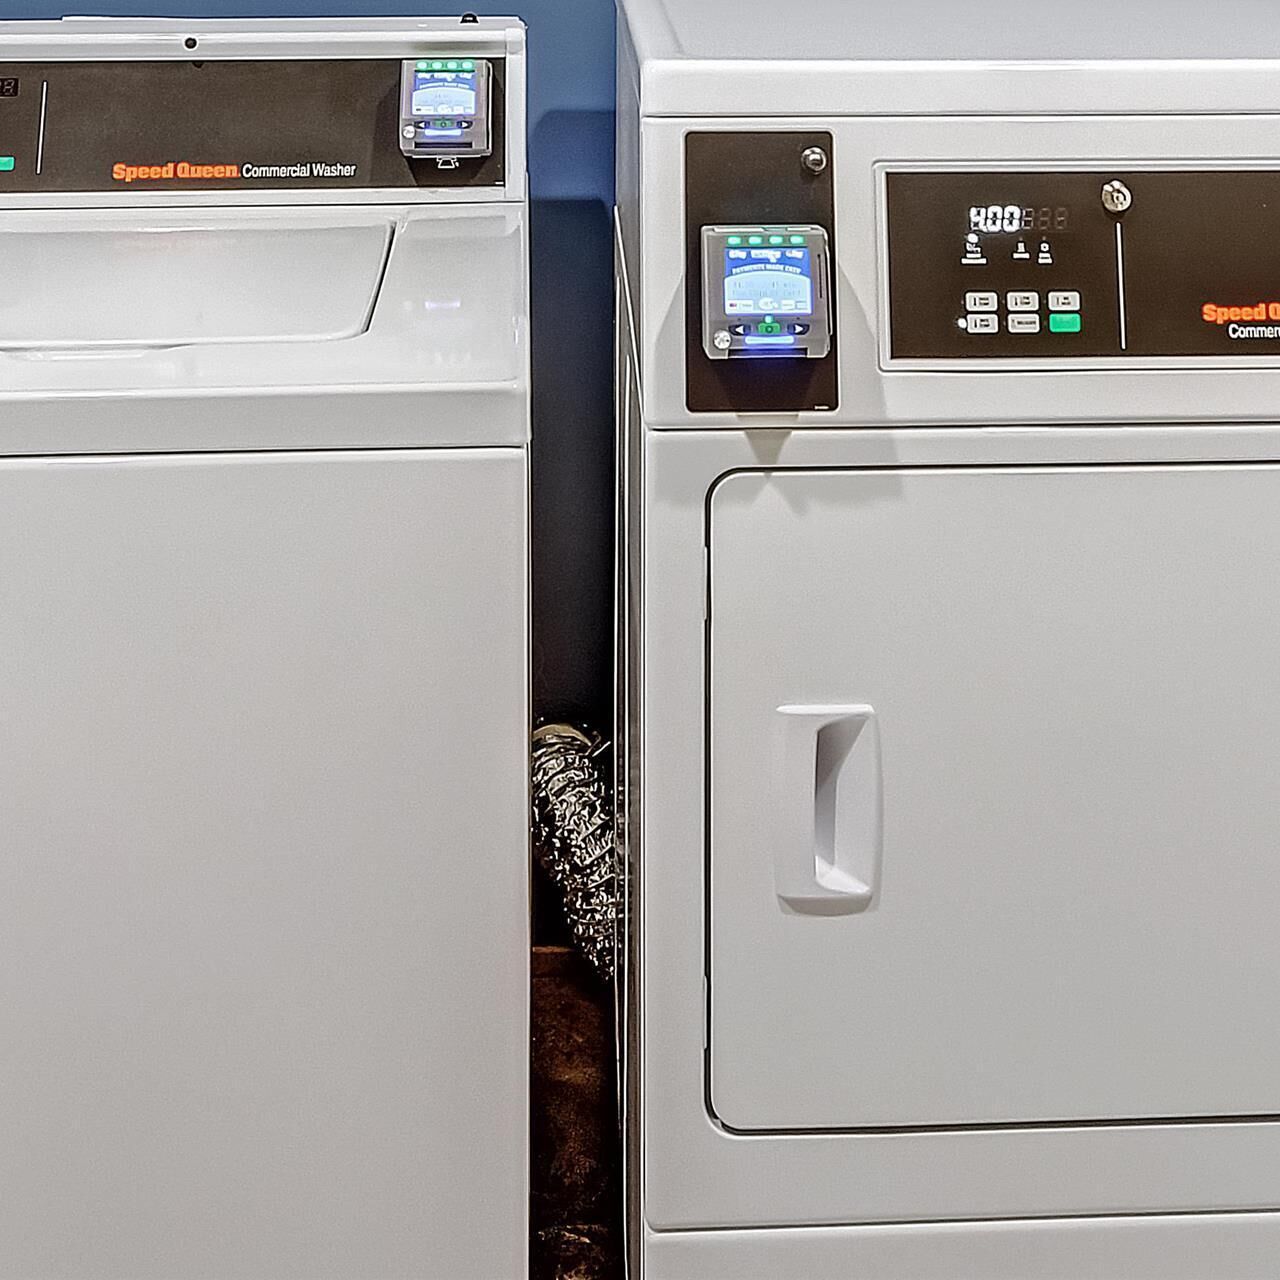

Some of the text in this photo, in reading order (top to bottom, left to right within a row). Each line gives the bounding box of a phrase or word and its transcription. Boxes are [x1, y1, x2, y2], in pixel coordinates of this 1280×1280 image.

[112, 162, 176, 182] Speed
[241, 163, 310, 178] Commercial
[312, 163, 357, 178] Washer
[1202, 303, 1266, 324] Speed
